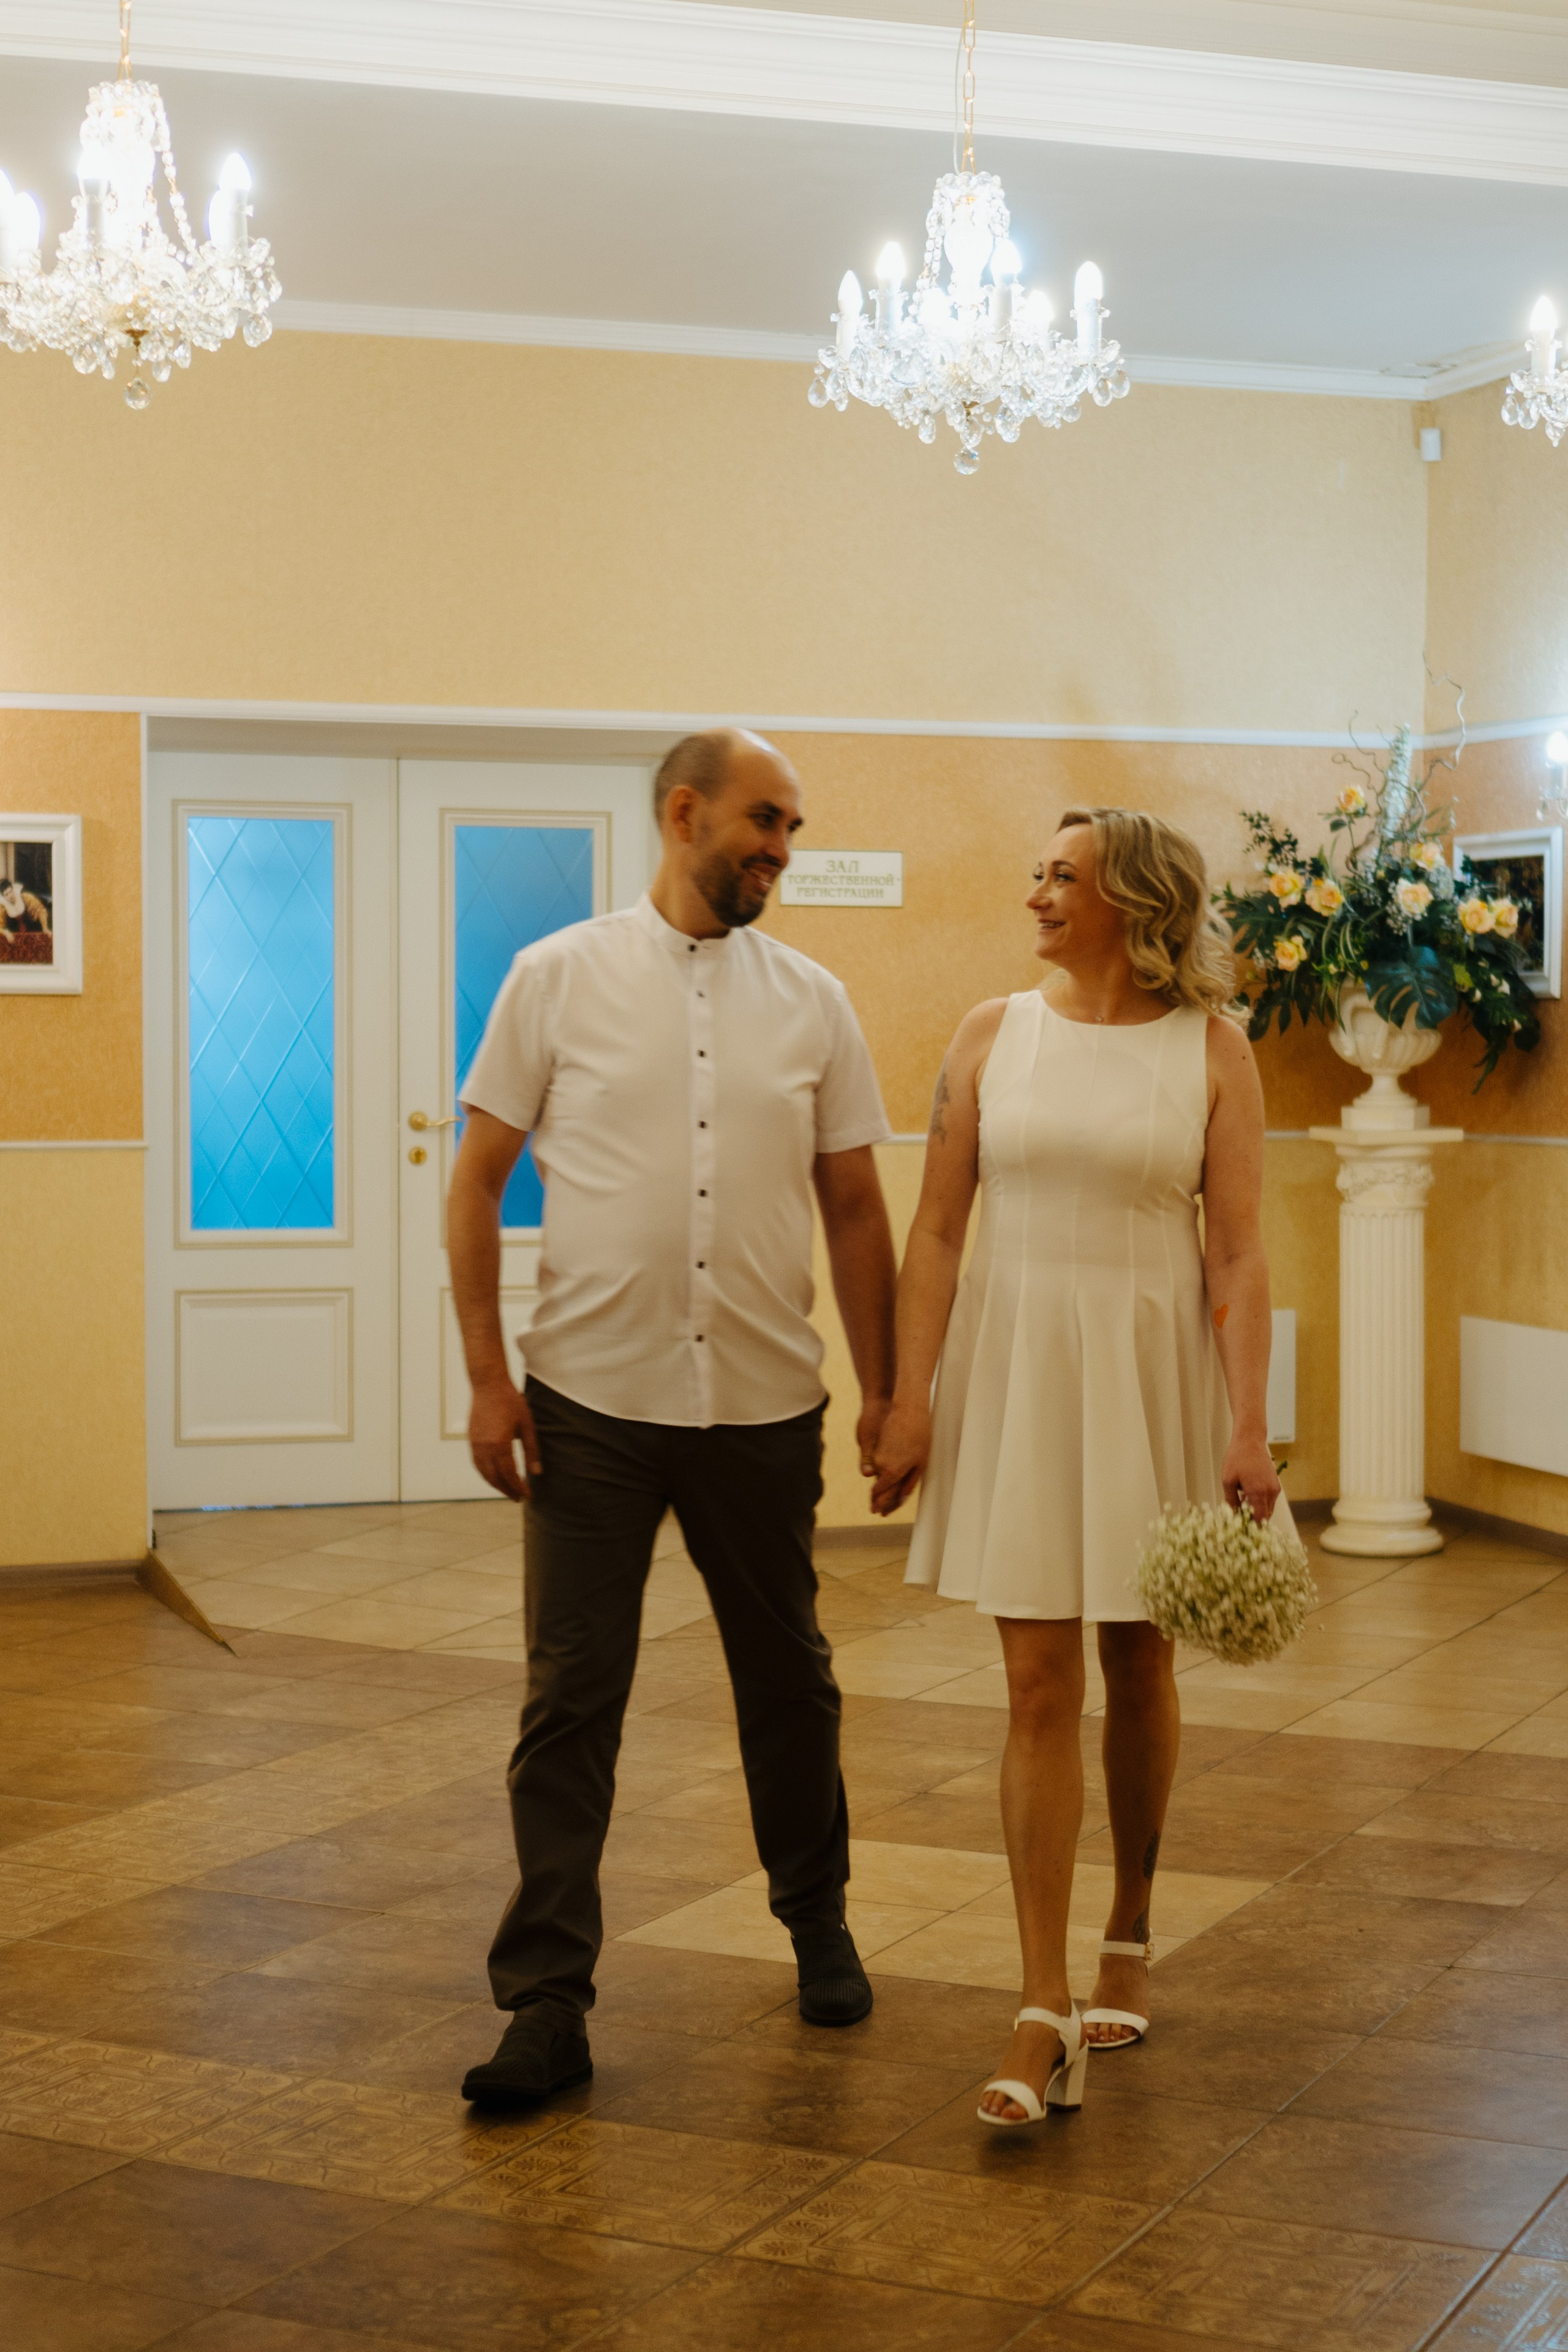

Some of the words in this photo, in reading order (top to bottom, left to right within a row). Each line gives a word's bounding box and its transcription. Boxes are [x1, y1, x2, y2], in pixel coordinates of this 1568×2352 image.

[826, 861, 859, 873] ЗАЛ
[787, 873, 894, 886] ТОРЖЕСТВЕННОЙ
[796, 888, 884, 898] РЕГИСТРАЦИИ
